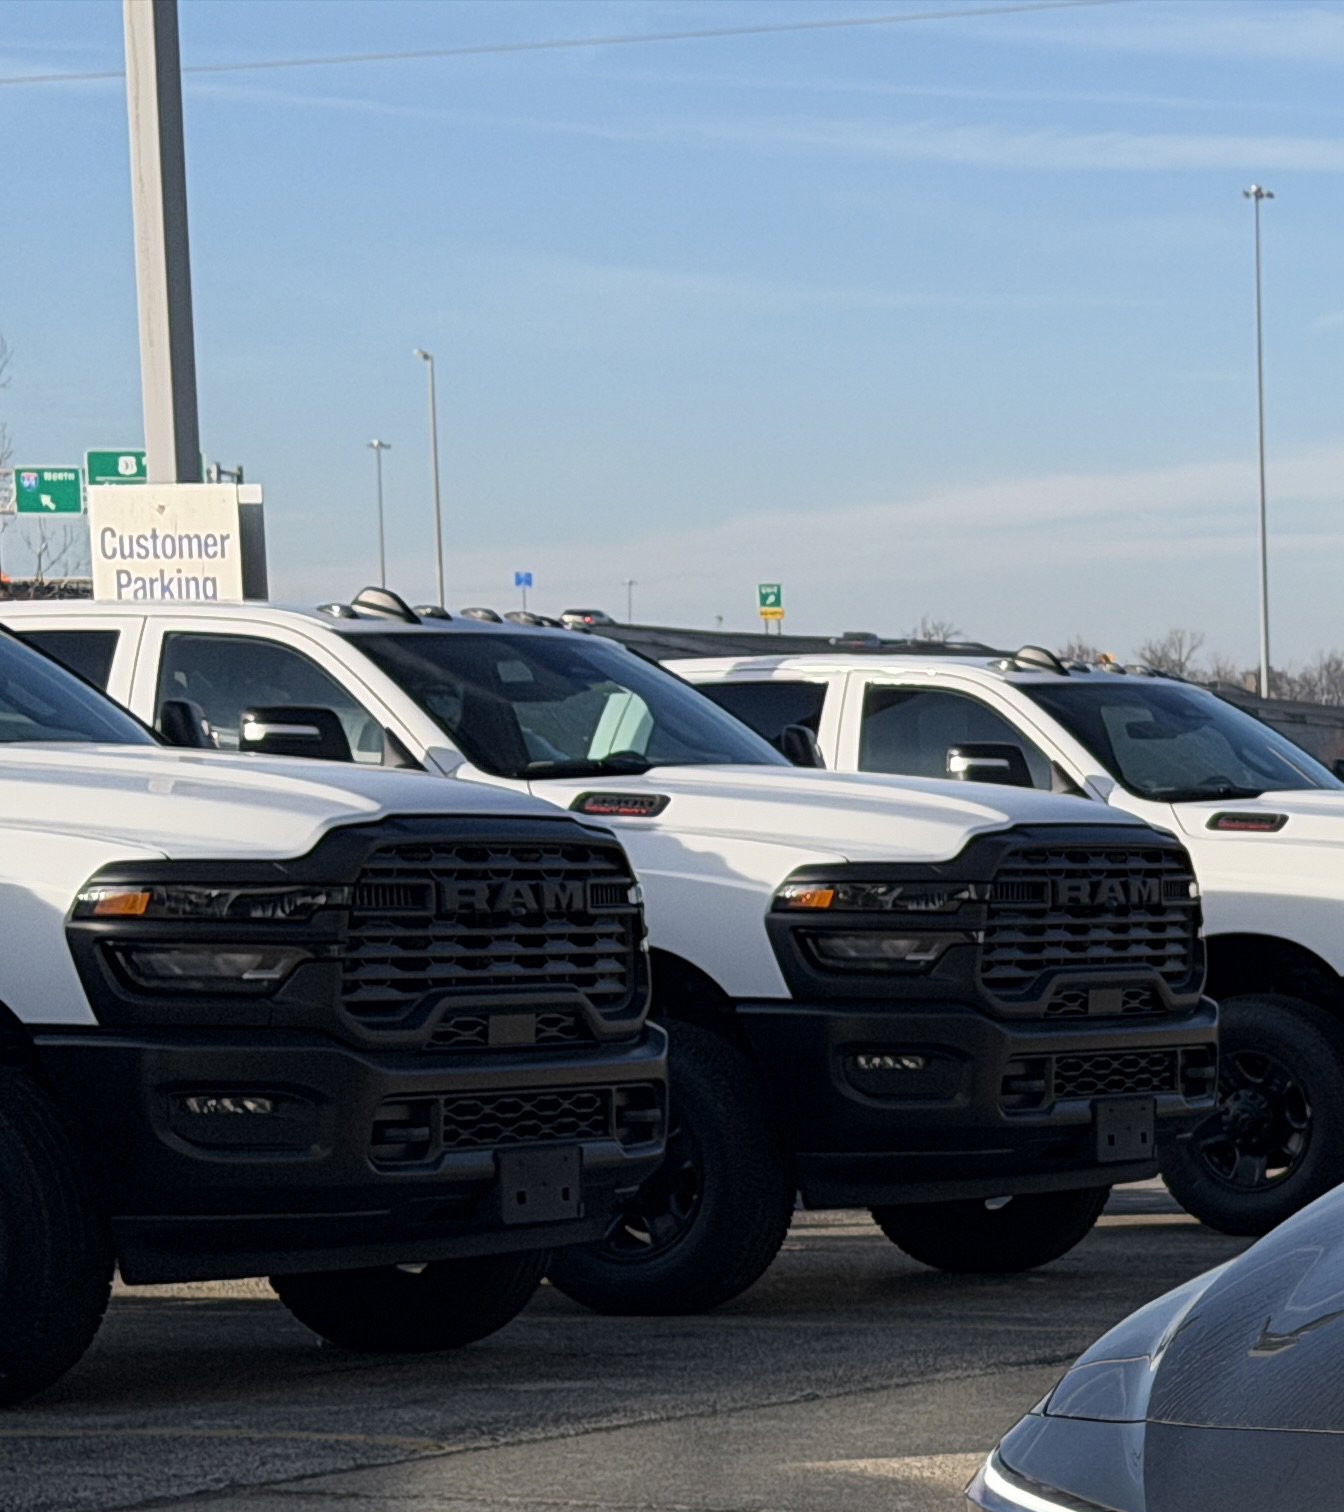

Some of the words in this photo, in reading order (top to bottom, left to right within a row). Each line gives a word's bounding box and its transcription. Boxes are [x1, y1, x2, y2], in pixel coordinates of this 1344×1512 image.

[100, 526, 231, 560] Customer
[115, 568, 219, 600] Parking
[442, 880, 585, 913] RAM
[1056, 878, 1160, 906] RAM
